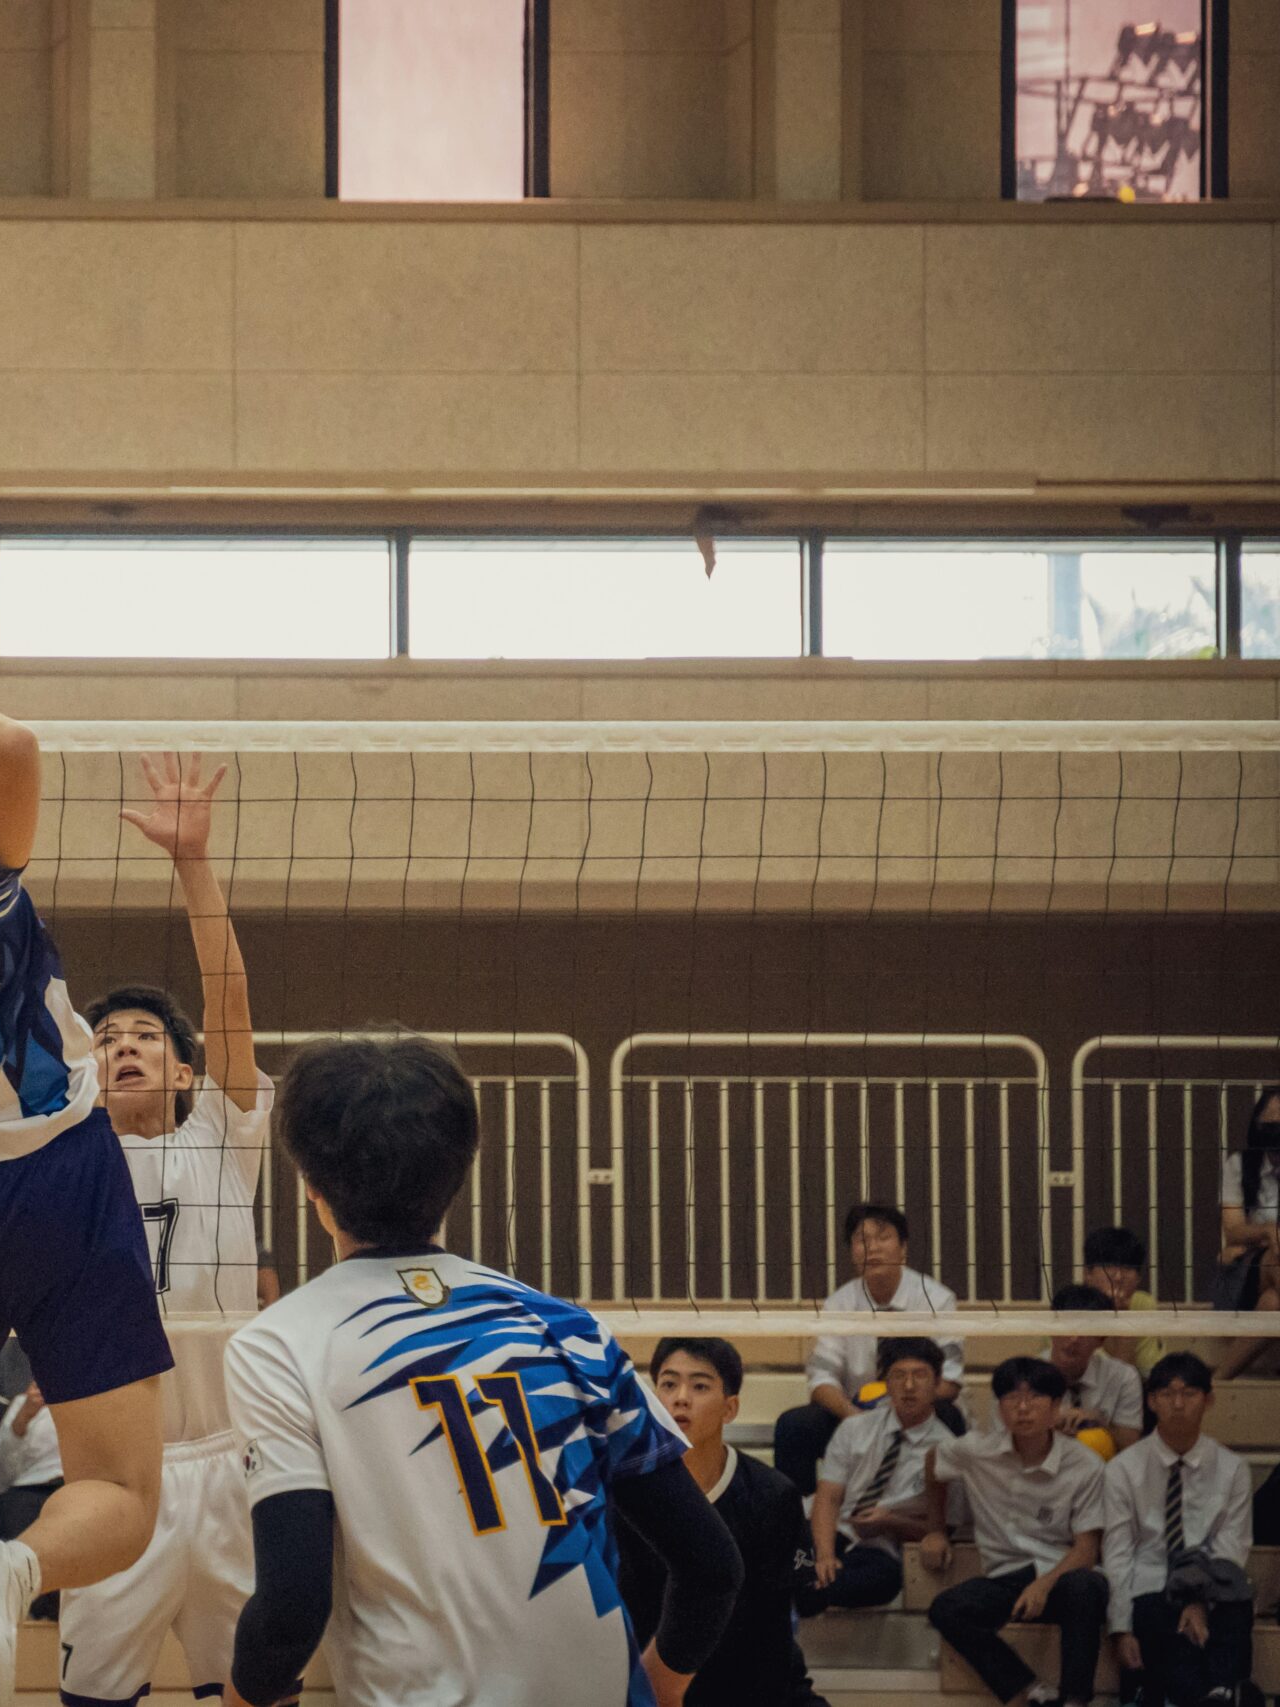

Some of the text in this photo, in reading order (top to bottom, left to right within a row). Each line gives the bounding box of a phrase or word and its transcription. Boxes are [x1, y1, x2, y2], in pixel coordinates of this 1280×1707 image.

[139, 1197, 180, 1294] 7
[408, 1371, 569, 1536] 11
[61, 1642, 74, 1681] 7
